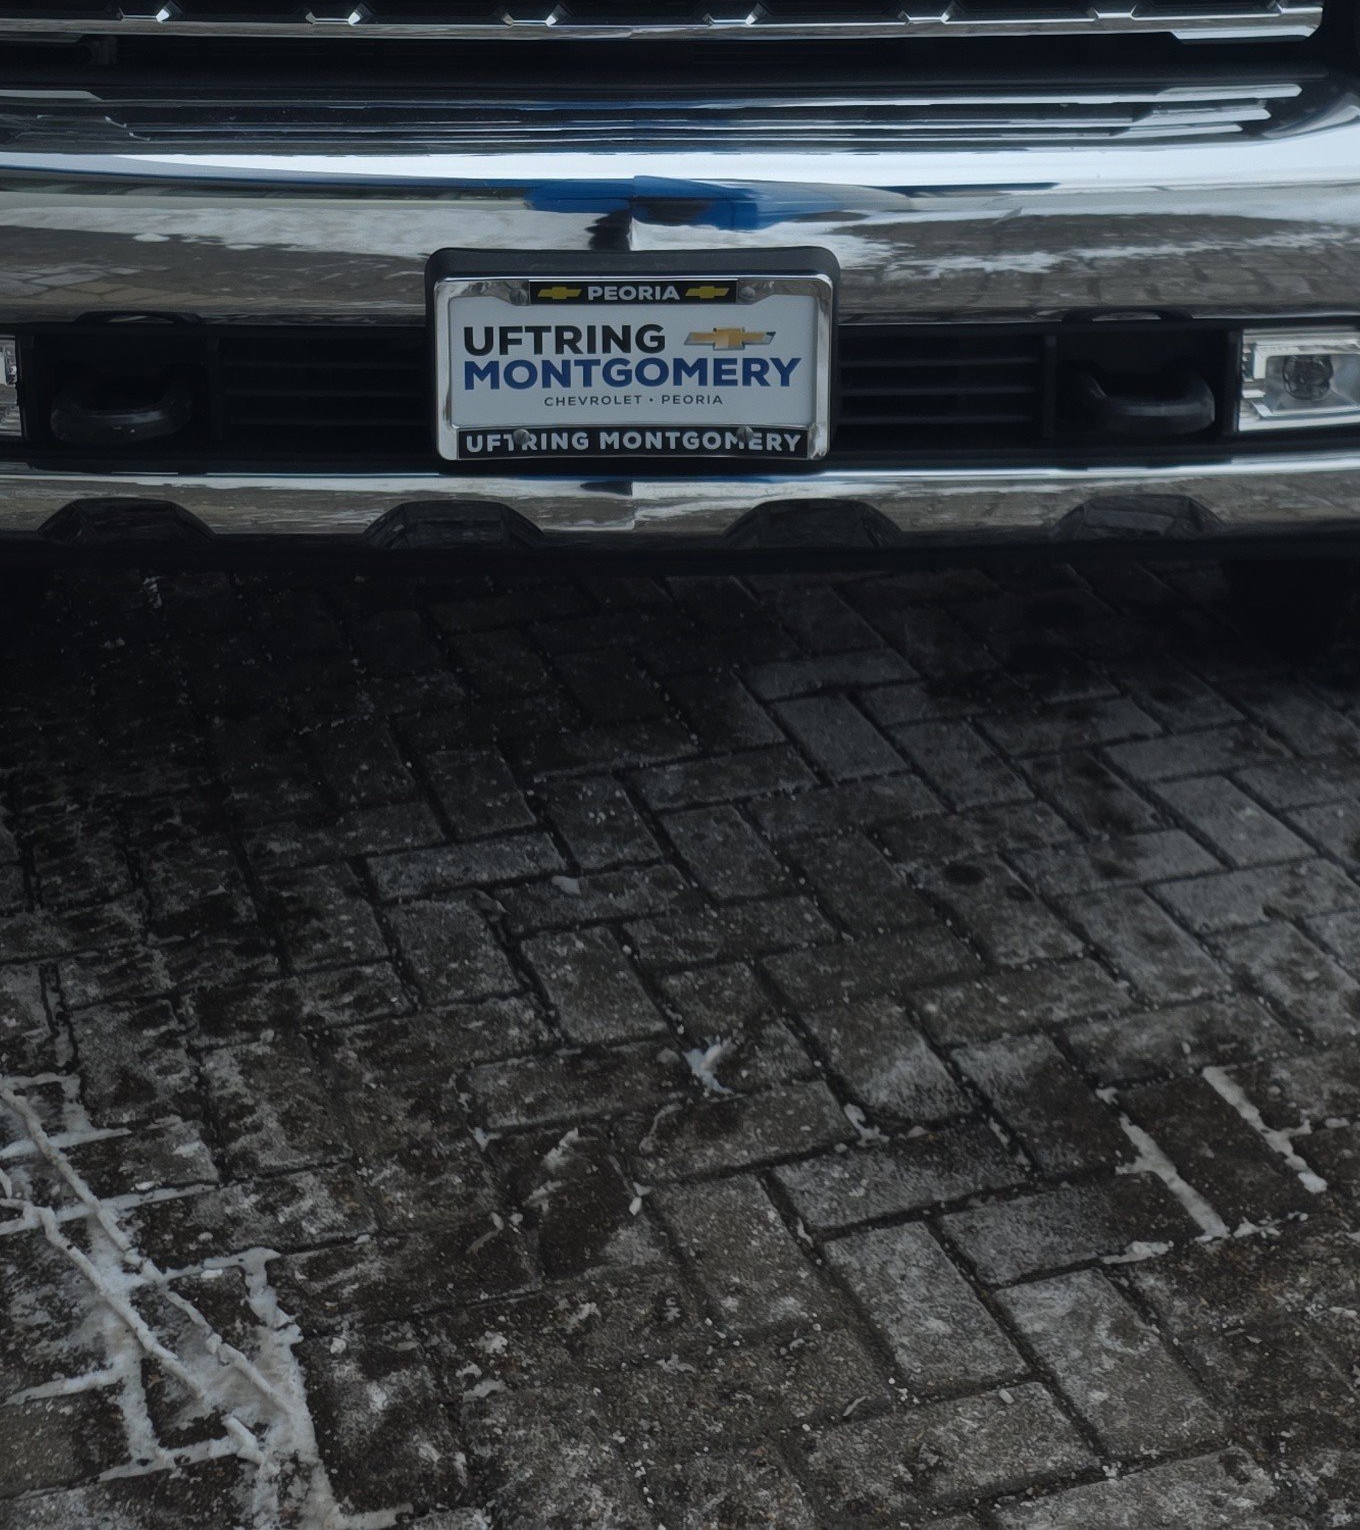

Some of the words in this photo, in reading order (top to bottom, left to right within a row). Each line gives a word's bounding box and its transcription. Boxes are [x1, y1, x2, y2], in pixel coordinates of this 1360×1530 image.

[586, 285, 681, 302] PEORIA
[463, 324, 666, 357] UFTRING
[464, 356, 803, 391] MONTGOMERY
[543, 394, 644, 408] CHEVROLET
[661, 393, 724, 406] PEORIA
[466, 431, 590, 454] UFTRING
[598, 430, 802, 452] MONTGOMERY
